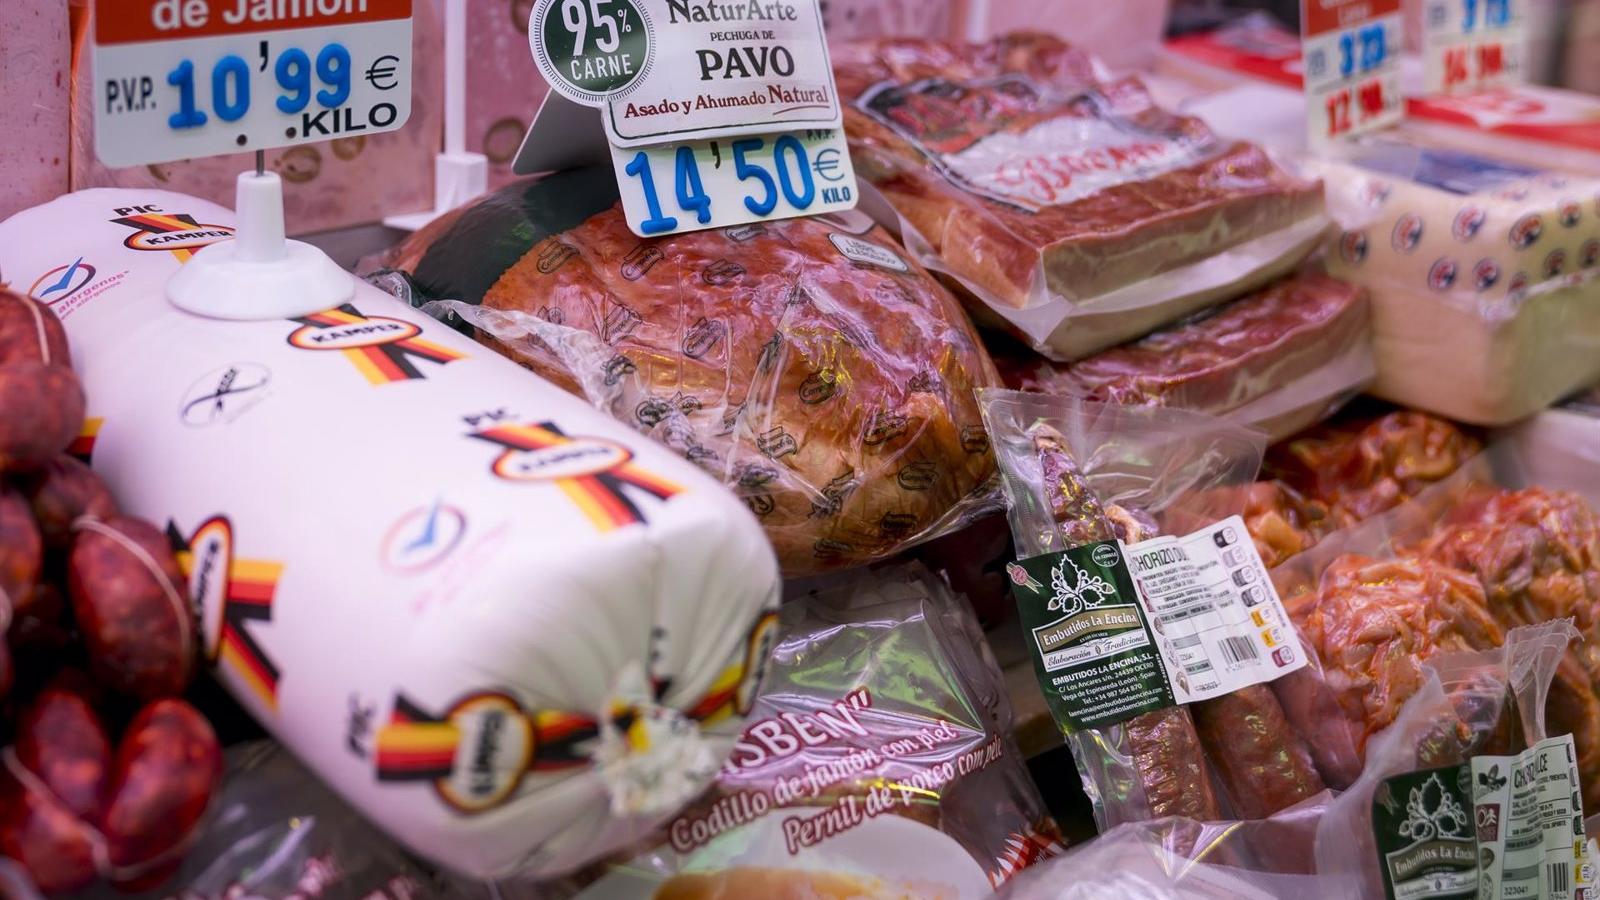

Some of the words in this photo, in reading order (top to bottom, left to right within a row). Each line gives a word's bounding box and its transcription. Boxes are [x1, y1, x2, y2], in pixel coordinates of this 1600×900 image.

[152, 0, 209, 31] de
[668, 0, 798, 24] NaturArte
[710, 31, 759, 42] PECHUGA
[762, 30, 775, 40] DE
[570, 54, 634, 81] CARNE
[696, 45, 796, 81] PAVO
[106, 76, 158, 115] P.V.P.
[167, 41, 352, 130] 10'99
[365, 55, 400, 91] €
[623, 102, 680, 119] Asado
[682, 101, 692, 115] y
[695, 94, 767, 111] Ahumado
[768, 84, 830, 104] Natural
[302, 102, 398, 138] KILO
[812, 148, 845, 182] €
[822, 186, 852, 204] KILO
[113, 204, 164, 217] PIC
[145, 229, 234, 246] KAMPER
[312, 322, 405, 344] KAMPER
[1043, 618, 1091, 646] Embutidos
[1092, 615, 1104, 627] La
[1104, 612, 1138, 625] Encina
[1104, 633, 1146, 652] Tradicional
[1052, 667, 1098, 686] EMBUTIDOS
[1098, 664, 1109, 674] LA
[1067, 683, 1078, 692] Los
[1078, 677, 1102, 688] Ancares
[1114, 667, 1134, 679] 24439
[1062, 692, 1077, 702] Vega
[1086, 681, 1118, 696] Espinareda
[1107, 689, 1118, 698] 987
[1118, 686, 1130, 695] 564
[1130, 682, 1143, 691] 870
[671, 792, 768, 851] Codillo
[774, 777, 803, 803] de
[881, 738, 919, 758] con
[917, 719, 957, 749] piel
[785, 795, 862, 852] Pernil
[866, 785, 894, 816] de
